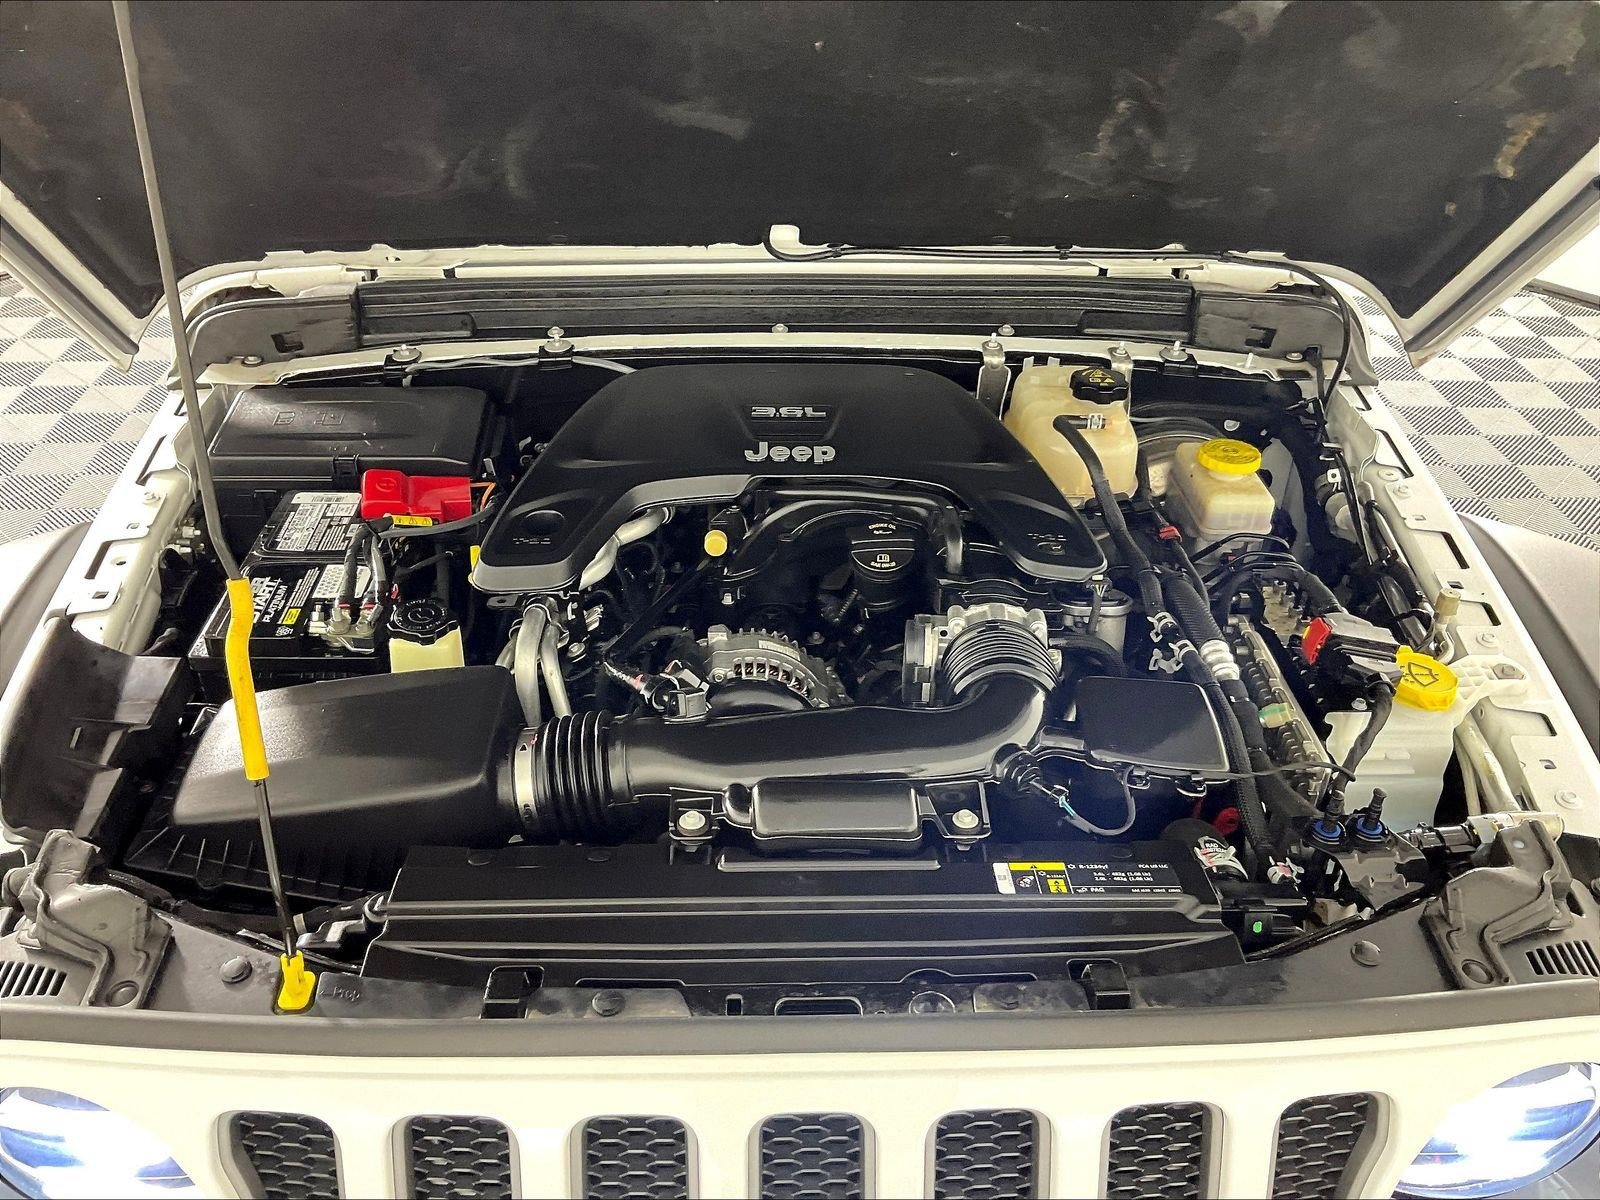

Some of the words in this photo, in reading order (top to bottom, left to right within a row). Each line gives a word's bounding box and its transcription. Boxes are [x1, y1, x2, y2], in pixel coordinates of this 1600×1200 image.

[751, 406, 827, 418] 3.6L
[744, 441, 836, 465] Jeep
[262, 585, 288, 622] PLATINUM
